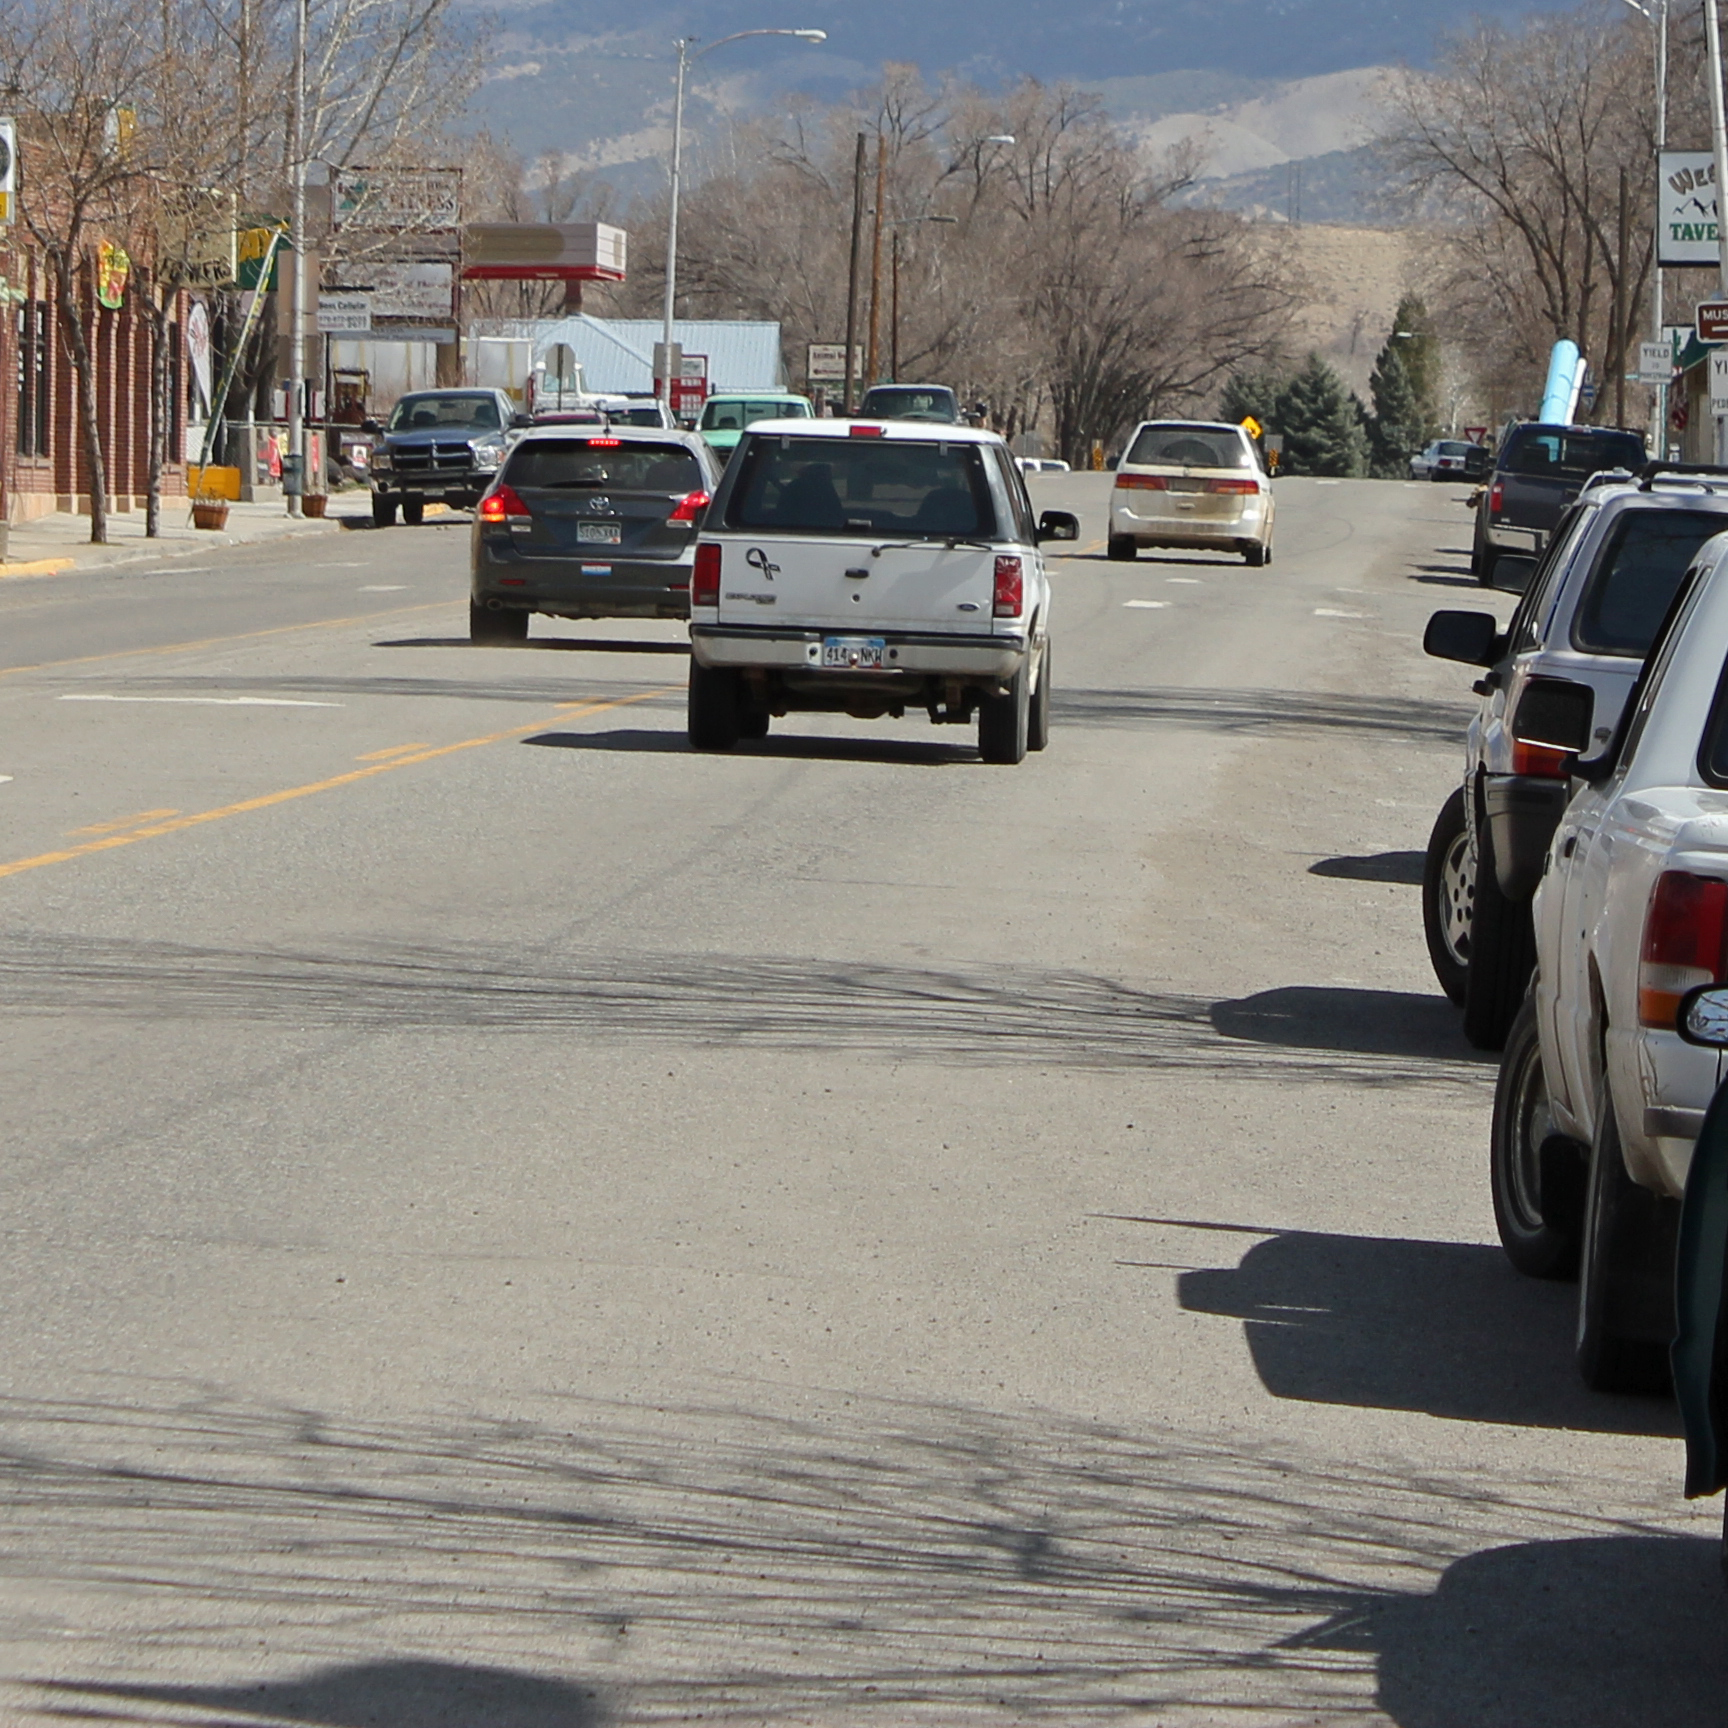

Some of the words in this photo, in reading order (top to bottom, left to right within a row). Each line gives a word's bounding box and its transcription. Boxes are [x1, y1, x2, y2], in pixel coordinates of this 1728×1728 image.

[1668, 163, 1718, 196] WES
[1642, 348, 1670, 358] YIELD
[826, 648, 847, 663] 414
